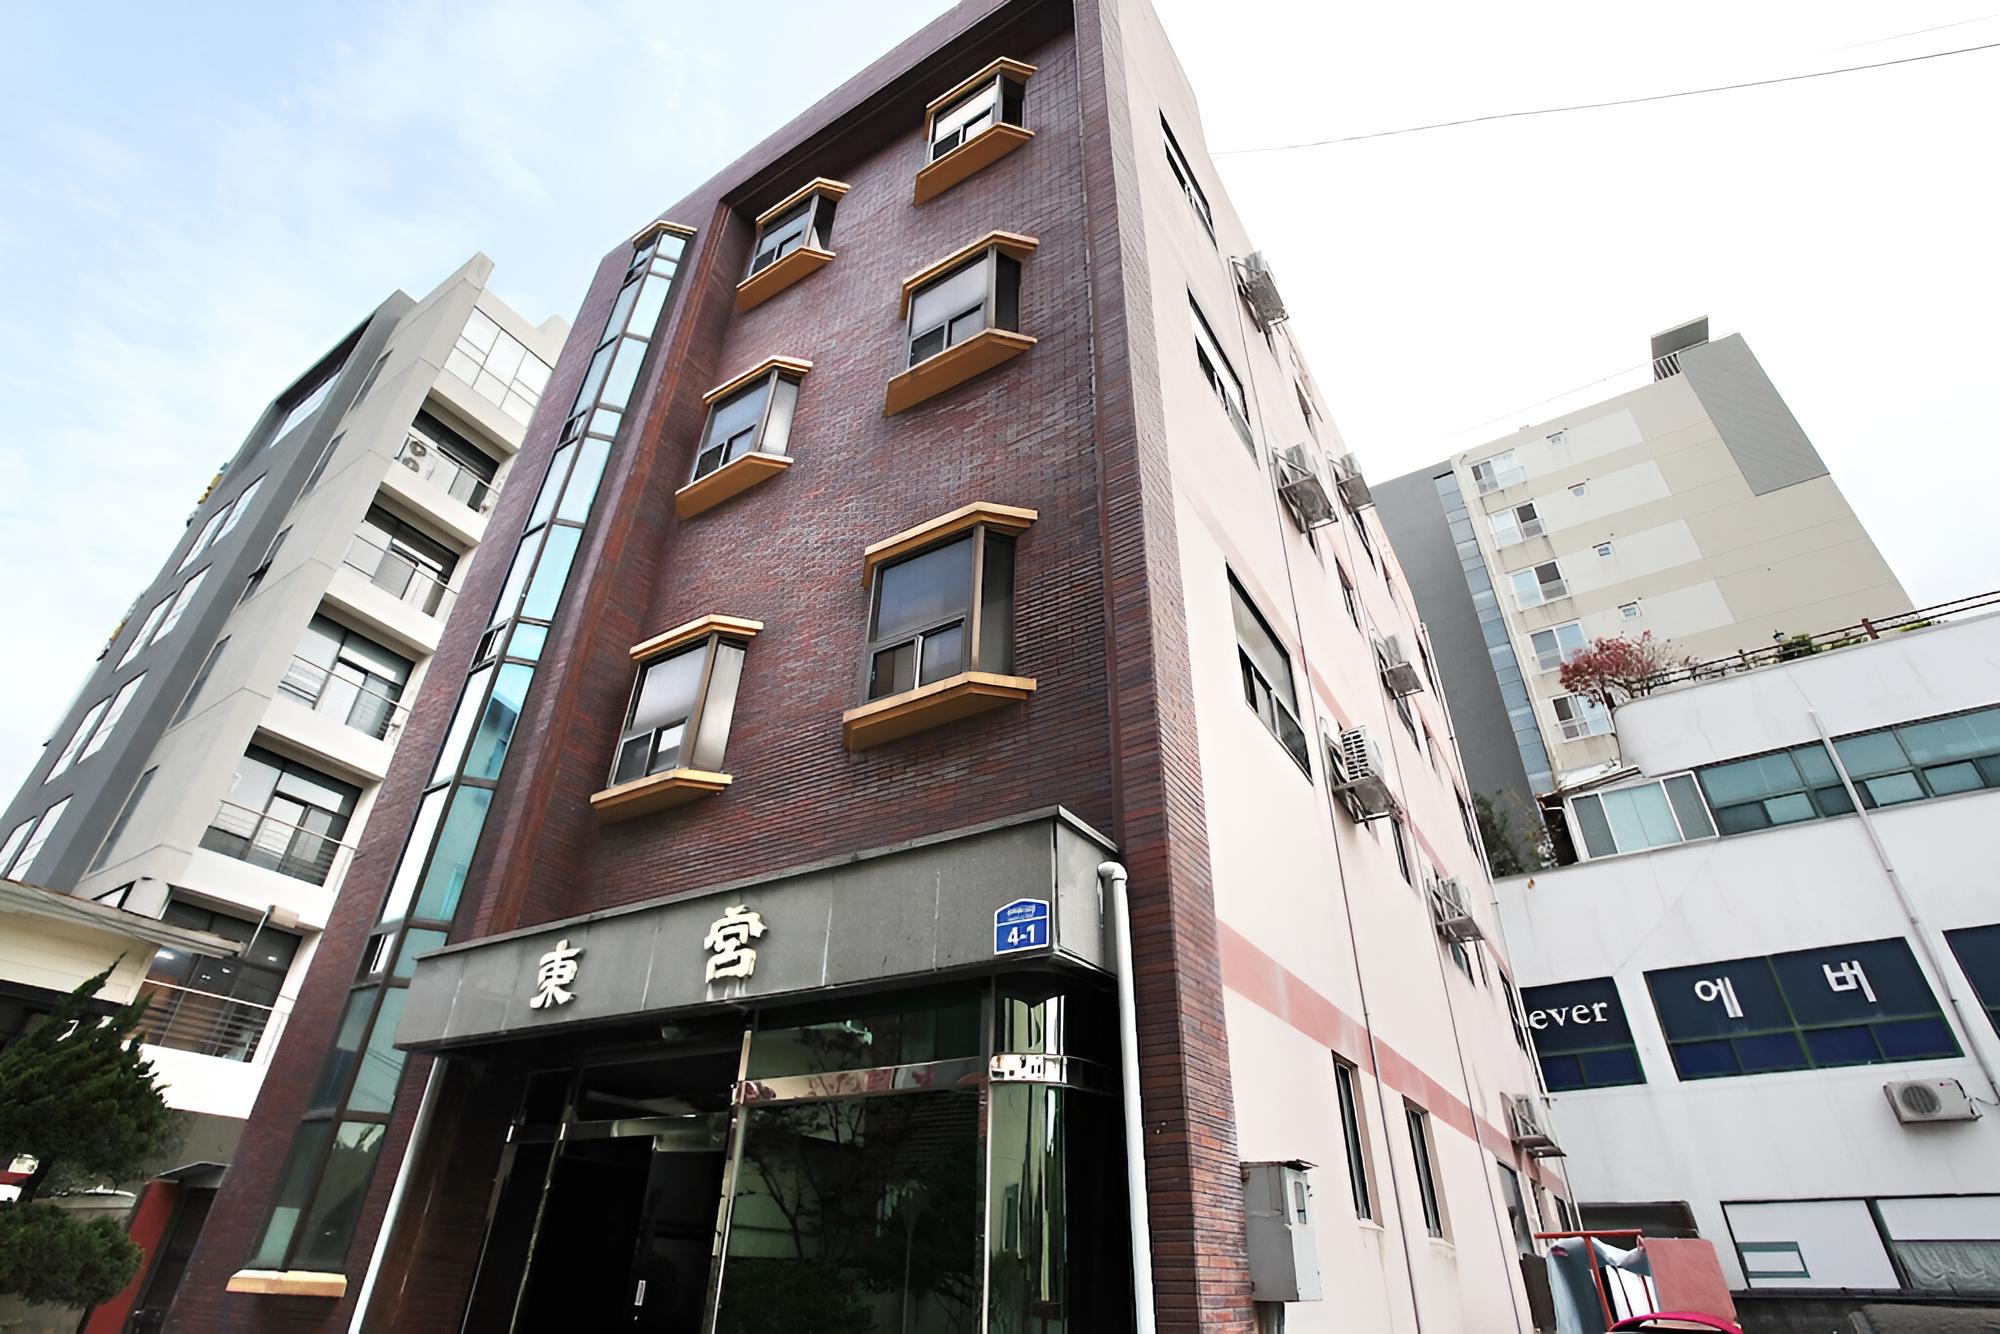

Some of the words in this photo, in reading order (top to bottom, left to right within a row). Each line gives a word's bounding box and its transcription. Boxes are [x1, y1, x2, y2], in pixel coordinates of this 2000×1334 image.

[1007, 924, 1036, 946] 4-1
[530, 905, 767, 1008] 東宮
[1529, 1001, 1608, 1030] ever
